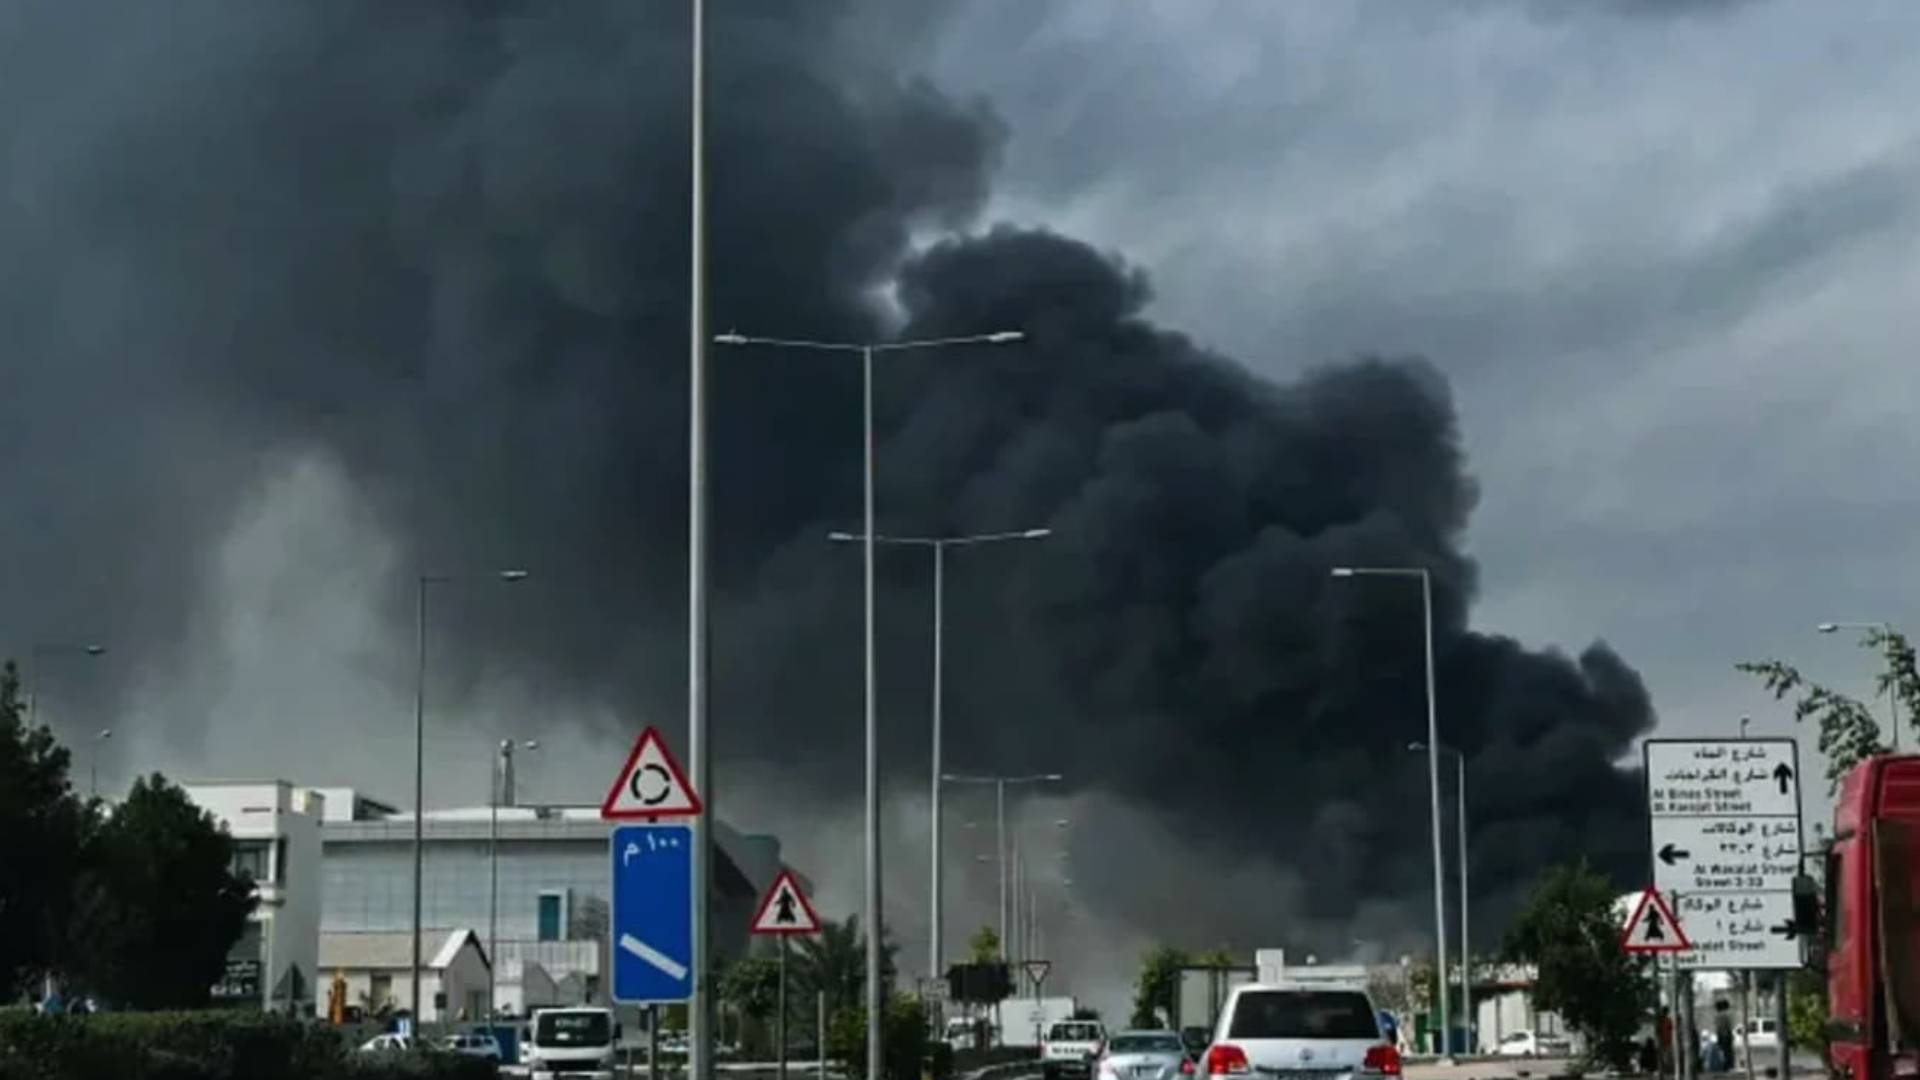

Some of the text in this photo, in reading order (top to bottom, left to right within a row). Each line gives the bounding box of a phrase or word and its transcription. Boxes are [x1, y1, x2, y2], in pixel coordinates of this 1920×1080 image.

[1732, 747, 1767, 762] شارع
[1734, 767, 1768, 784] شارع
[1704, 788, 1741, 799] Street
[1714, 801, 1751, 812] Street
[1762, 822, 1796, 837] شارع
[623, 831, 679, 867] ١٠٠ م
[1762, 843, 1797, 860] شارع
[1761, 863, 1798, 875] Street
[1696, 877, 1732, 887] Street
[1728, 898, 1763, 914] شارع
[1728, 920, 1763, 936] شارع
[1729, 940, 1765, 951] Street
